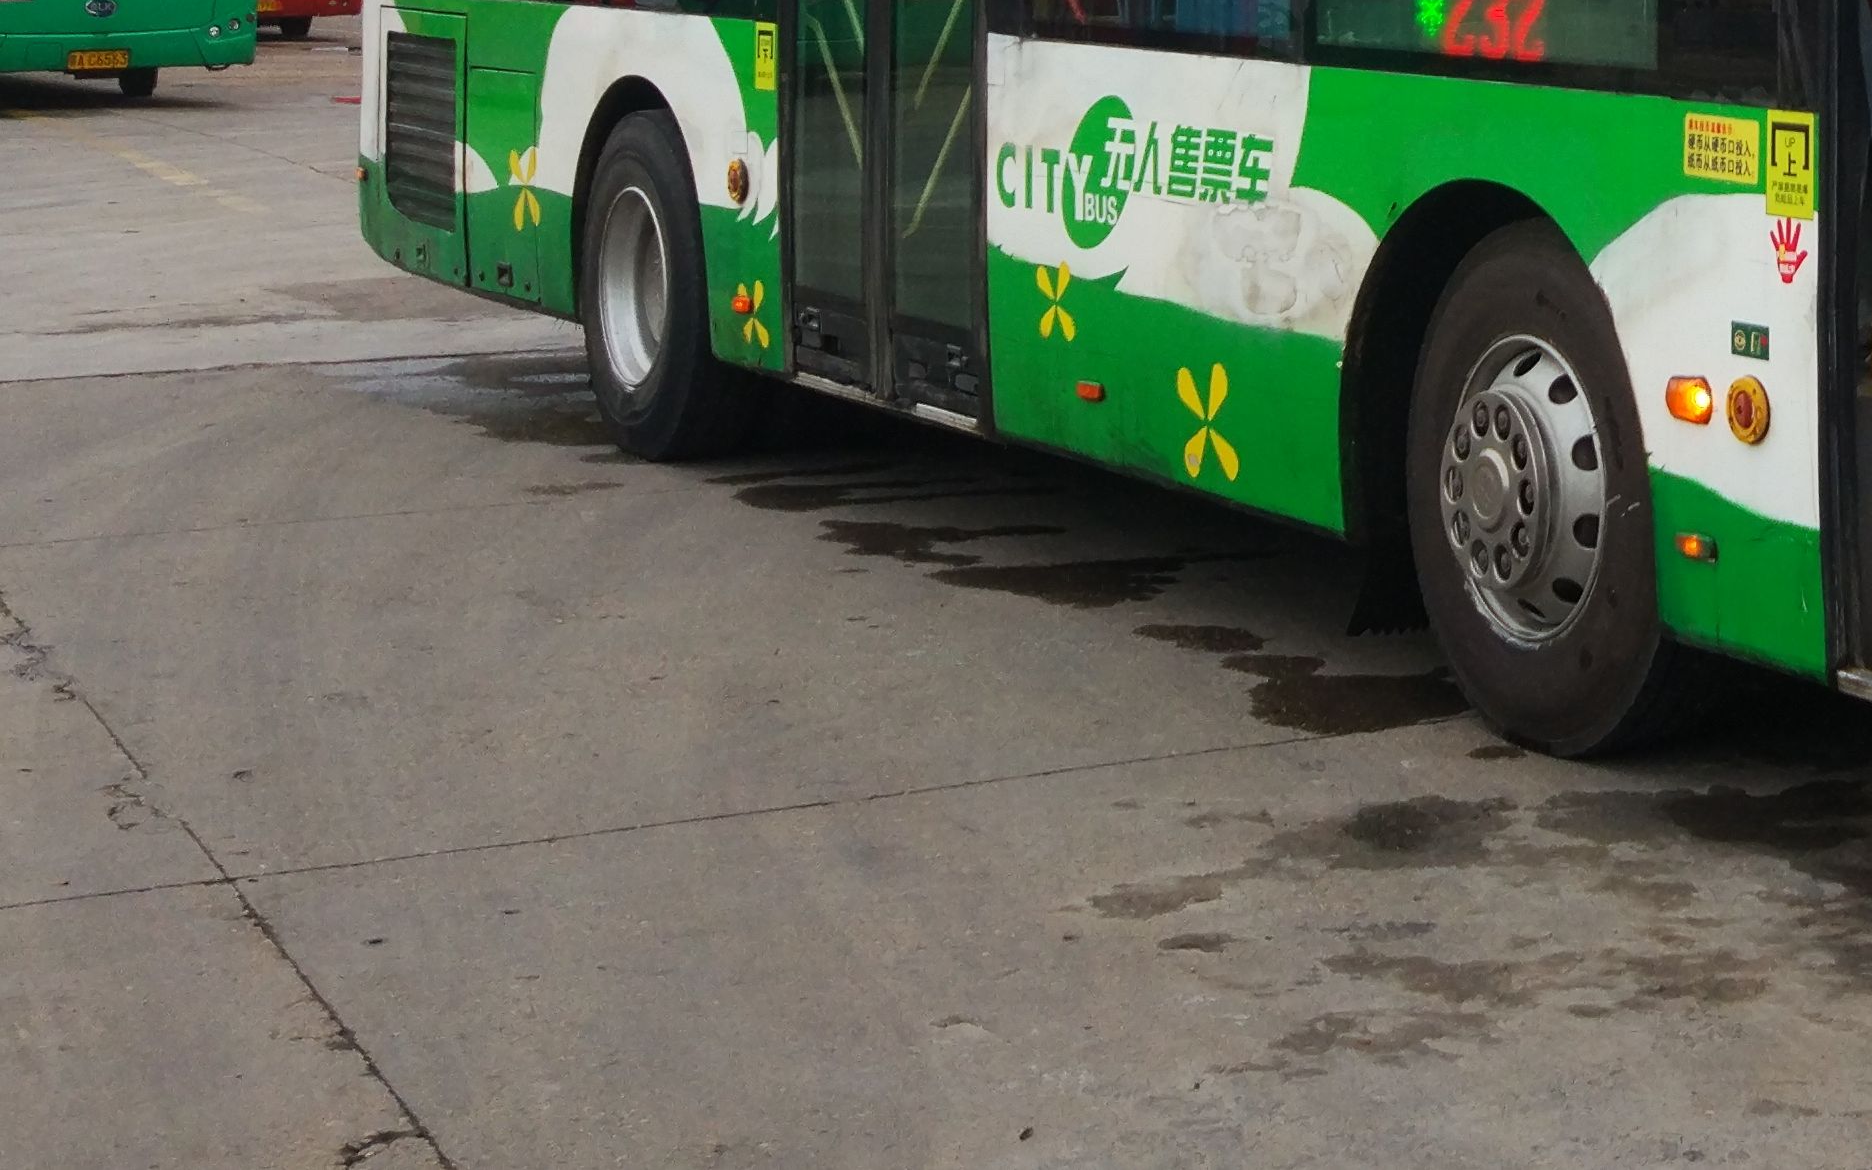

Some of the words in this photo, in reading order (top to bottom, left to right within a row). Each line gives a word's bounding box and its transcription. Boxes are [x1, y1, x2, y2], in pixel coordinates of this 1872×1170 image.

[1784, 136, 1796, 148] UP
[1101, 116, 1275, 205] 无人售票车
[1782, 151, 1798, 178] 上
[997, 141, 1094, 222] CITY
[1084, 195, 1119, 226] BUS
